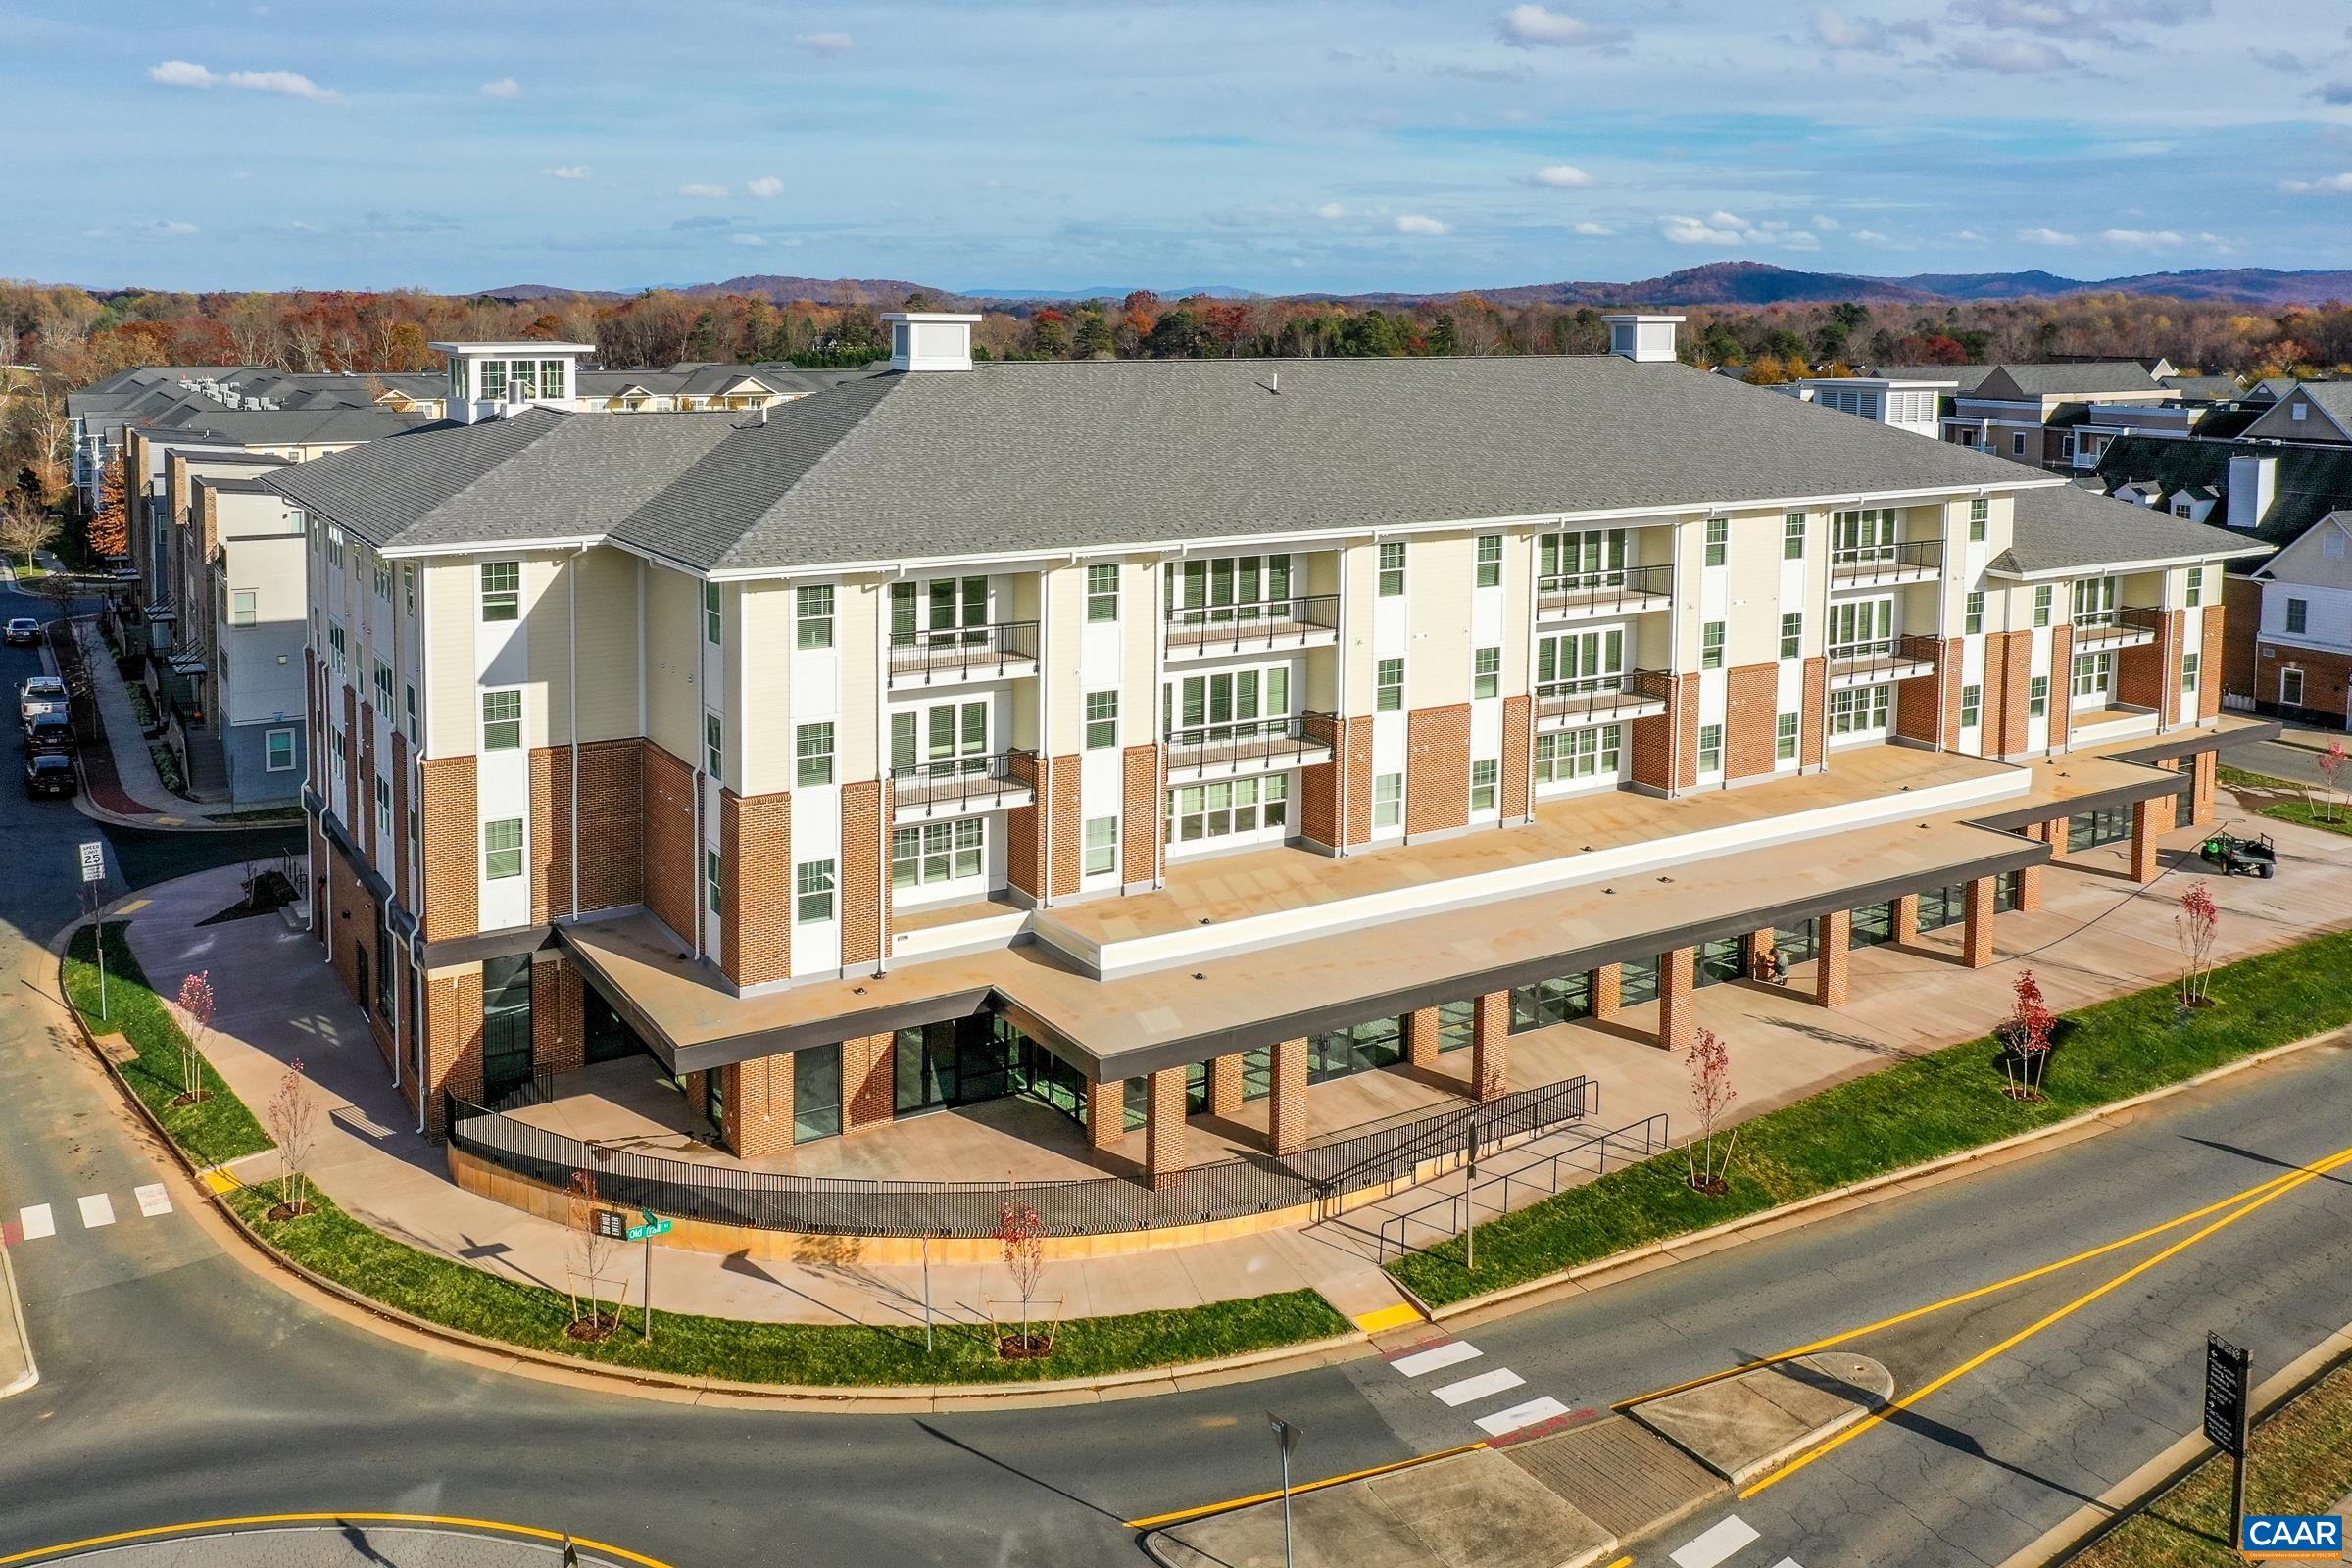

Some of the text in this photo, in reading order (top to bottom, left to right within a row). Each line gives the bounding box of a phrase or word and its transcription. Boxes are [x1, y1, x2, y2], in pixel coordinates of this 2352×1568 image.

[84, 854, 100, 863] 25
[602, 1213, 611, 1235] DO NOT
[611, 1216, 620, 1236] ENTER
[629, 1227, 643, 1239] Old
